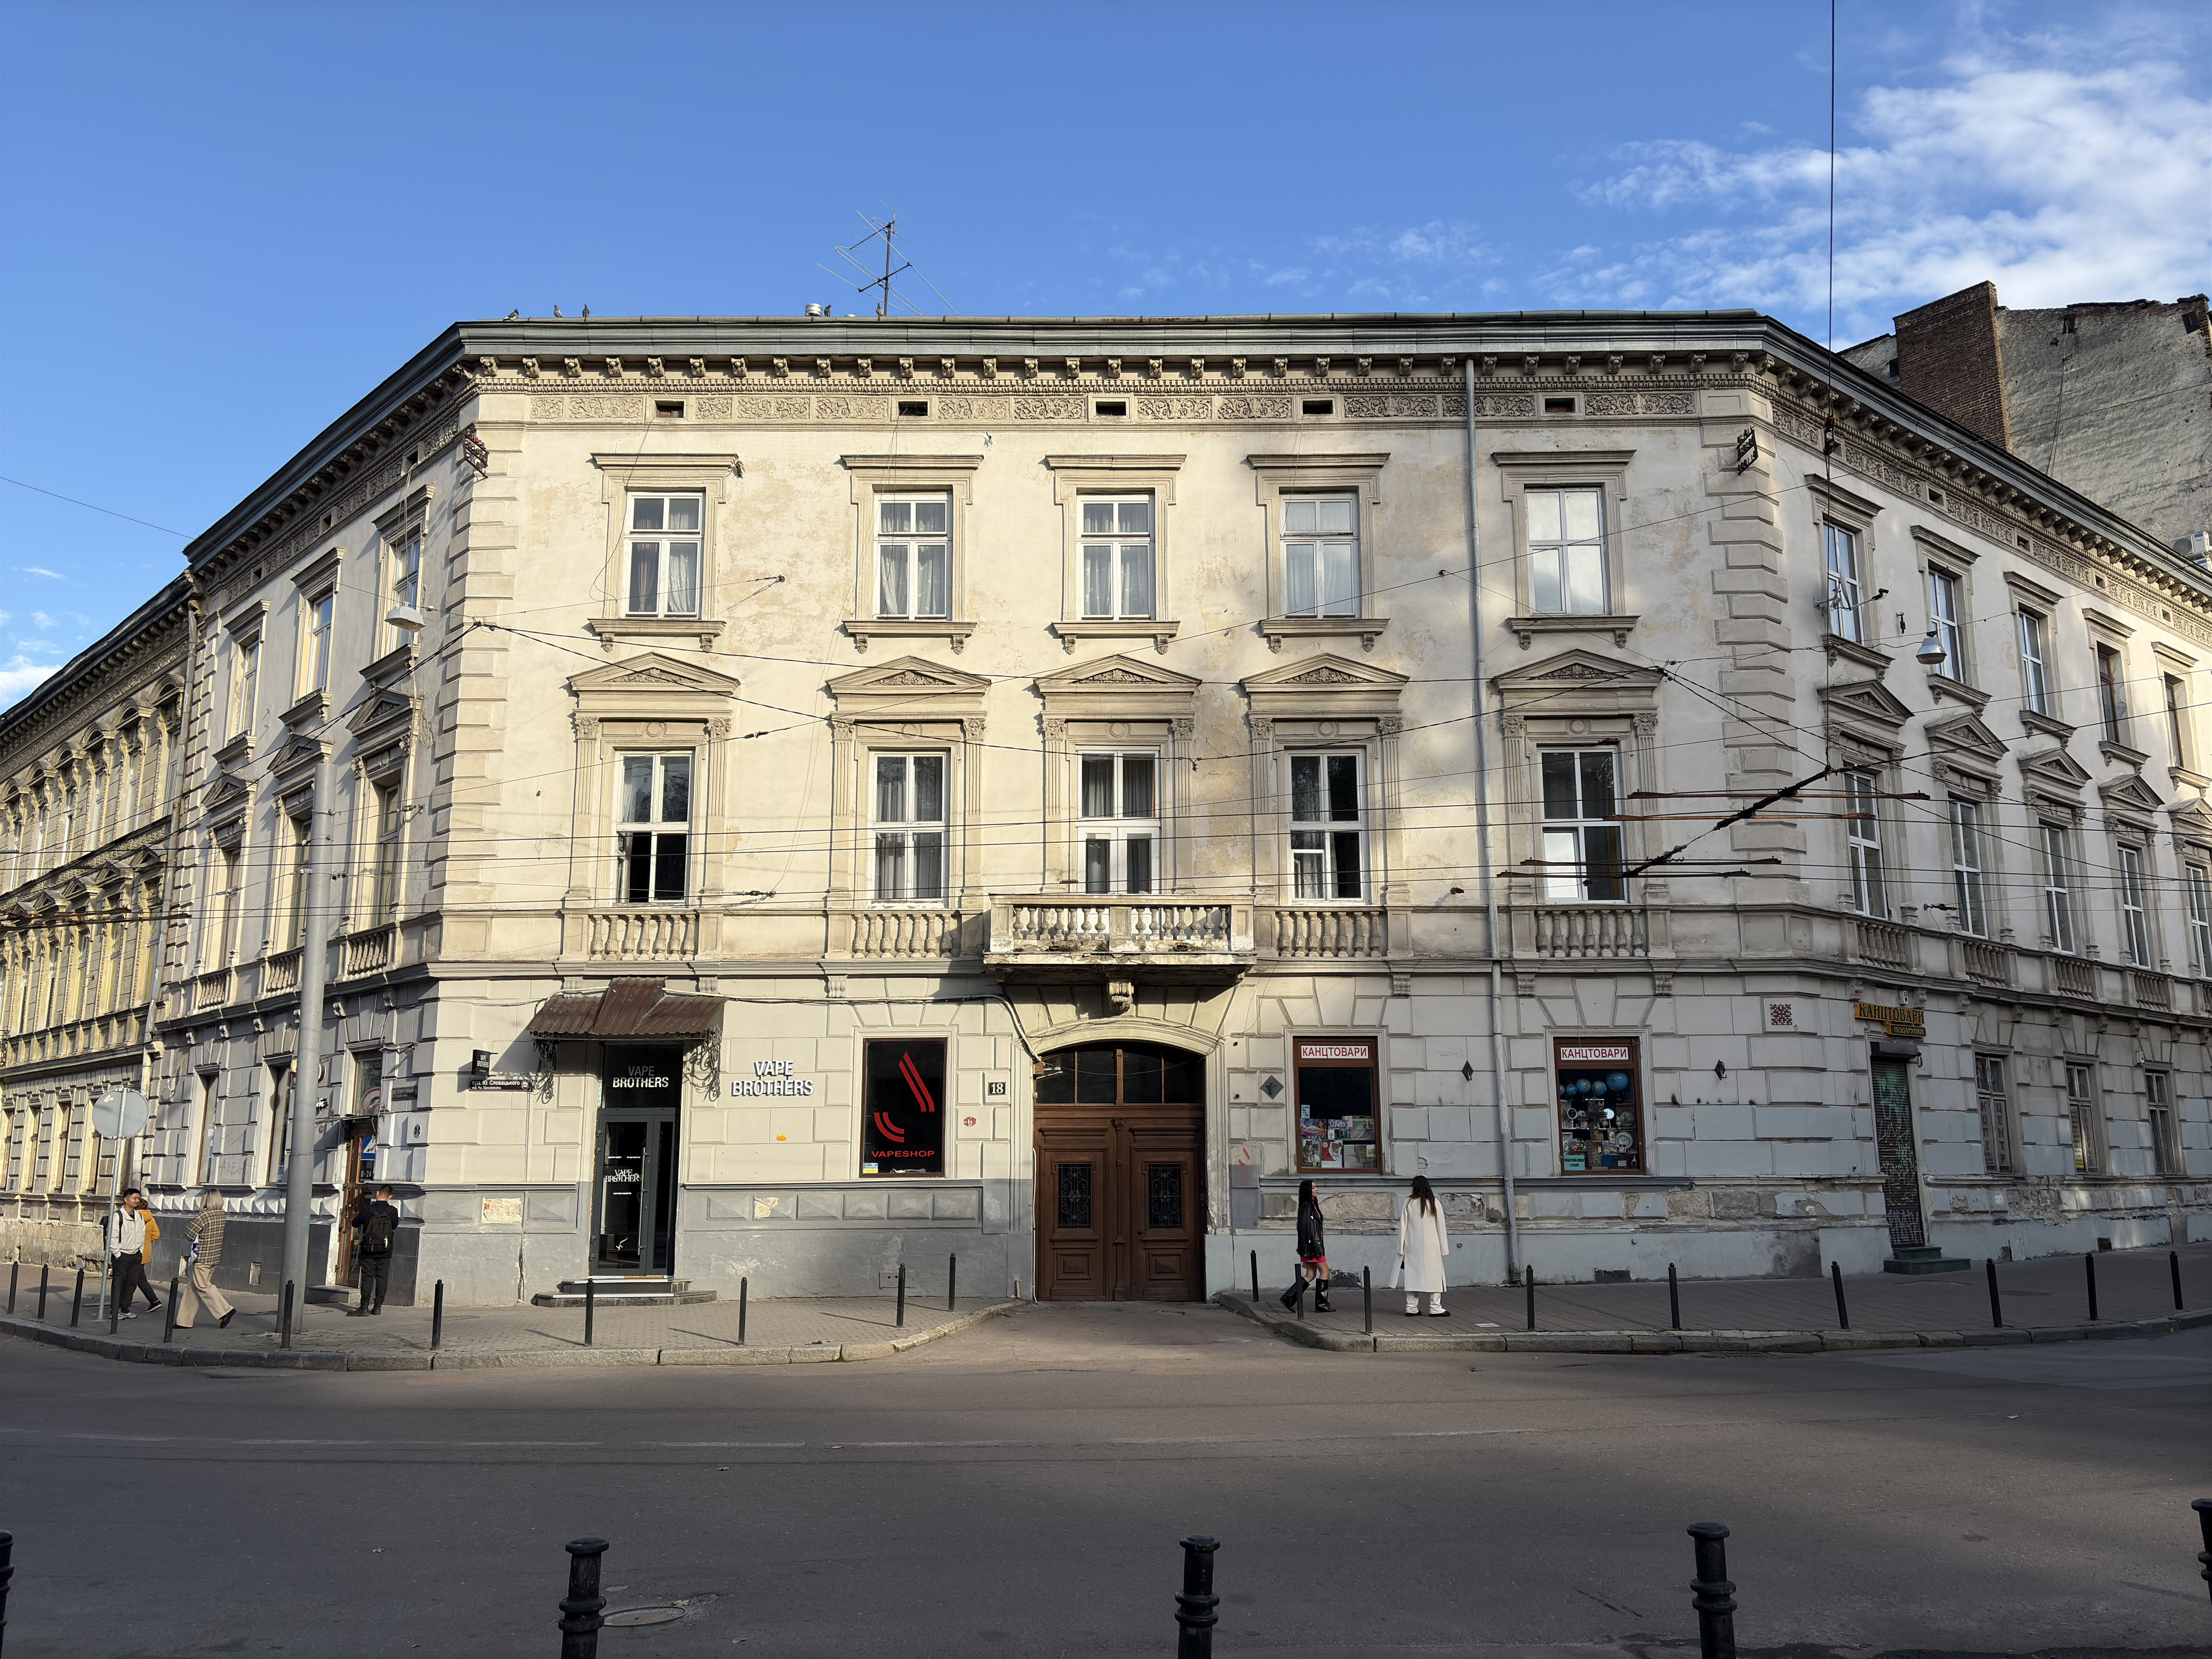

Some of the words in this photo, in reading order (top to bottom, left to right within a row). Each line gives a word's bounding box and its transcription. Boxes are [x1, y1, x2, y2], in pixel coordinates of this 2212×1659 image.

[1859, 1003, 1924, 1024] КАНЦТОВАРИ
[1894, 1026, 1924, 1035] ПОДАРУНКИ
[1302, 1047, 1366, 1058] КАНЦТОВАРИ
[1562, 1048, 1627, 1060] КАНЦТОВАРИ
[628, 1066, 655, 1076] VAPE
[754, 1060, 794, 1076] VAPE
[613, 1077, 669, 1088] BROTHERS
[732, 1080, 814, 1095] BROTHERS
[991, 1083, 1003, 1094] 18
[1996, 1102, 2006, 1164] ЦЕНТР
